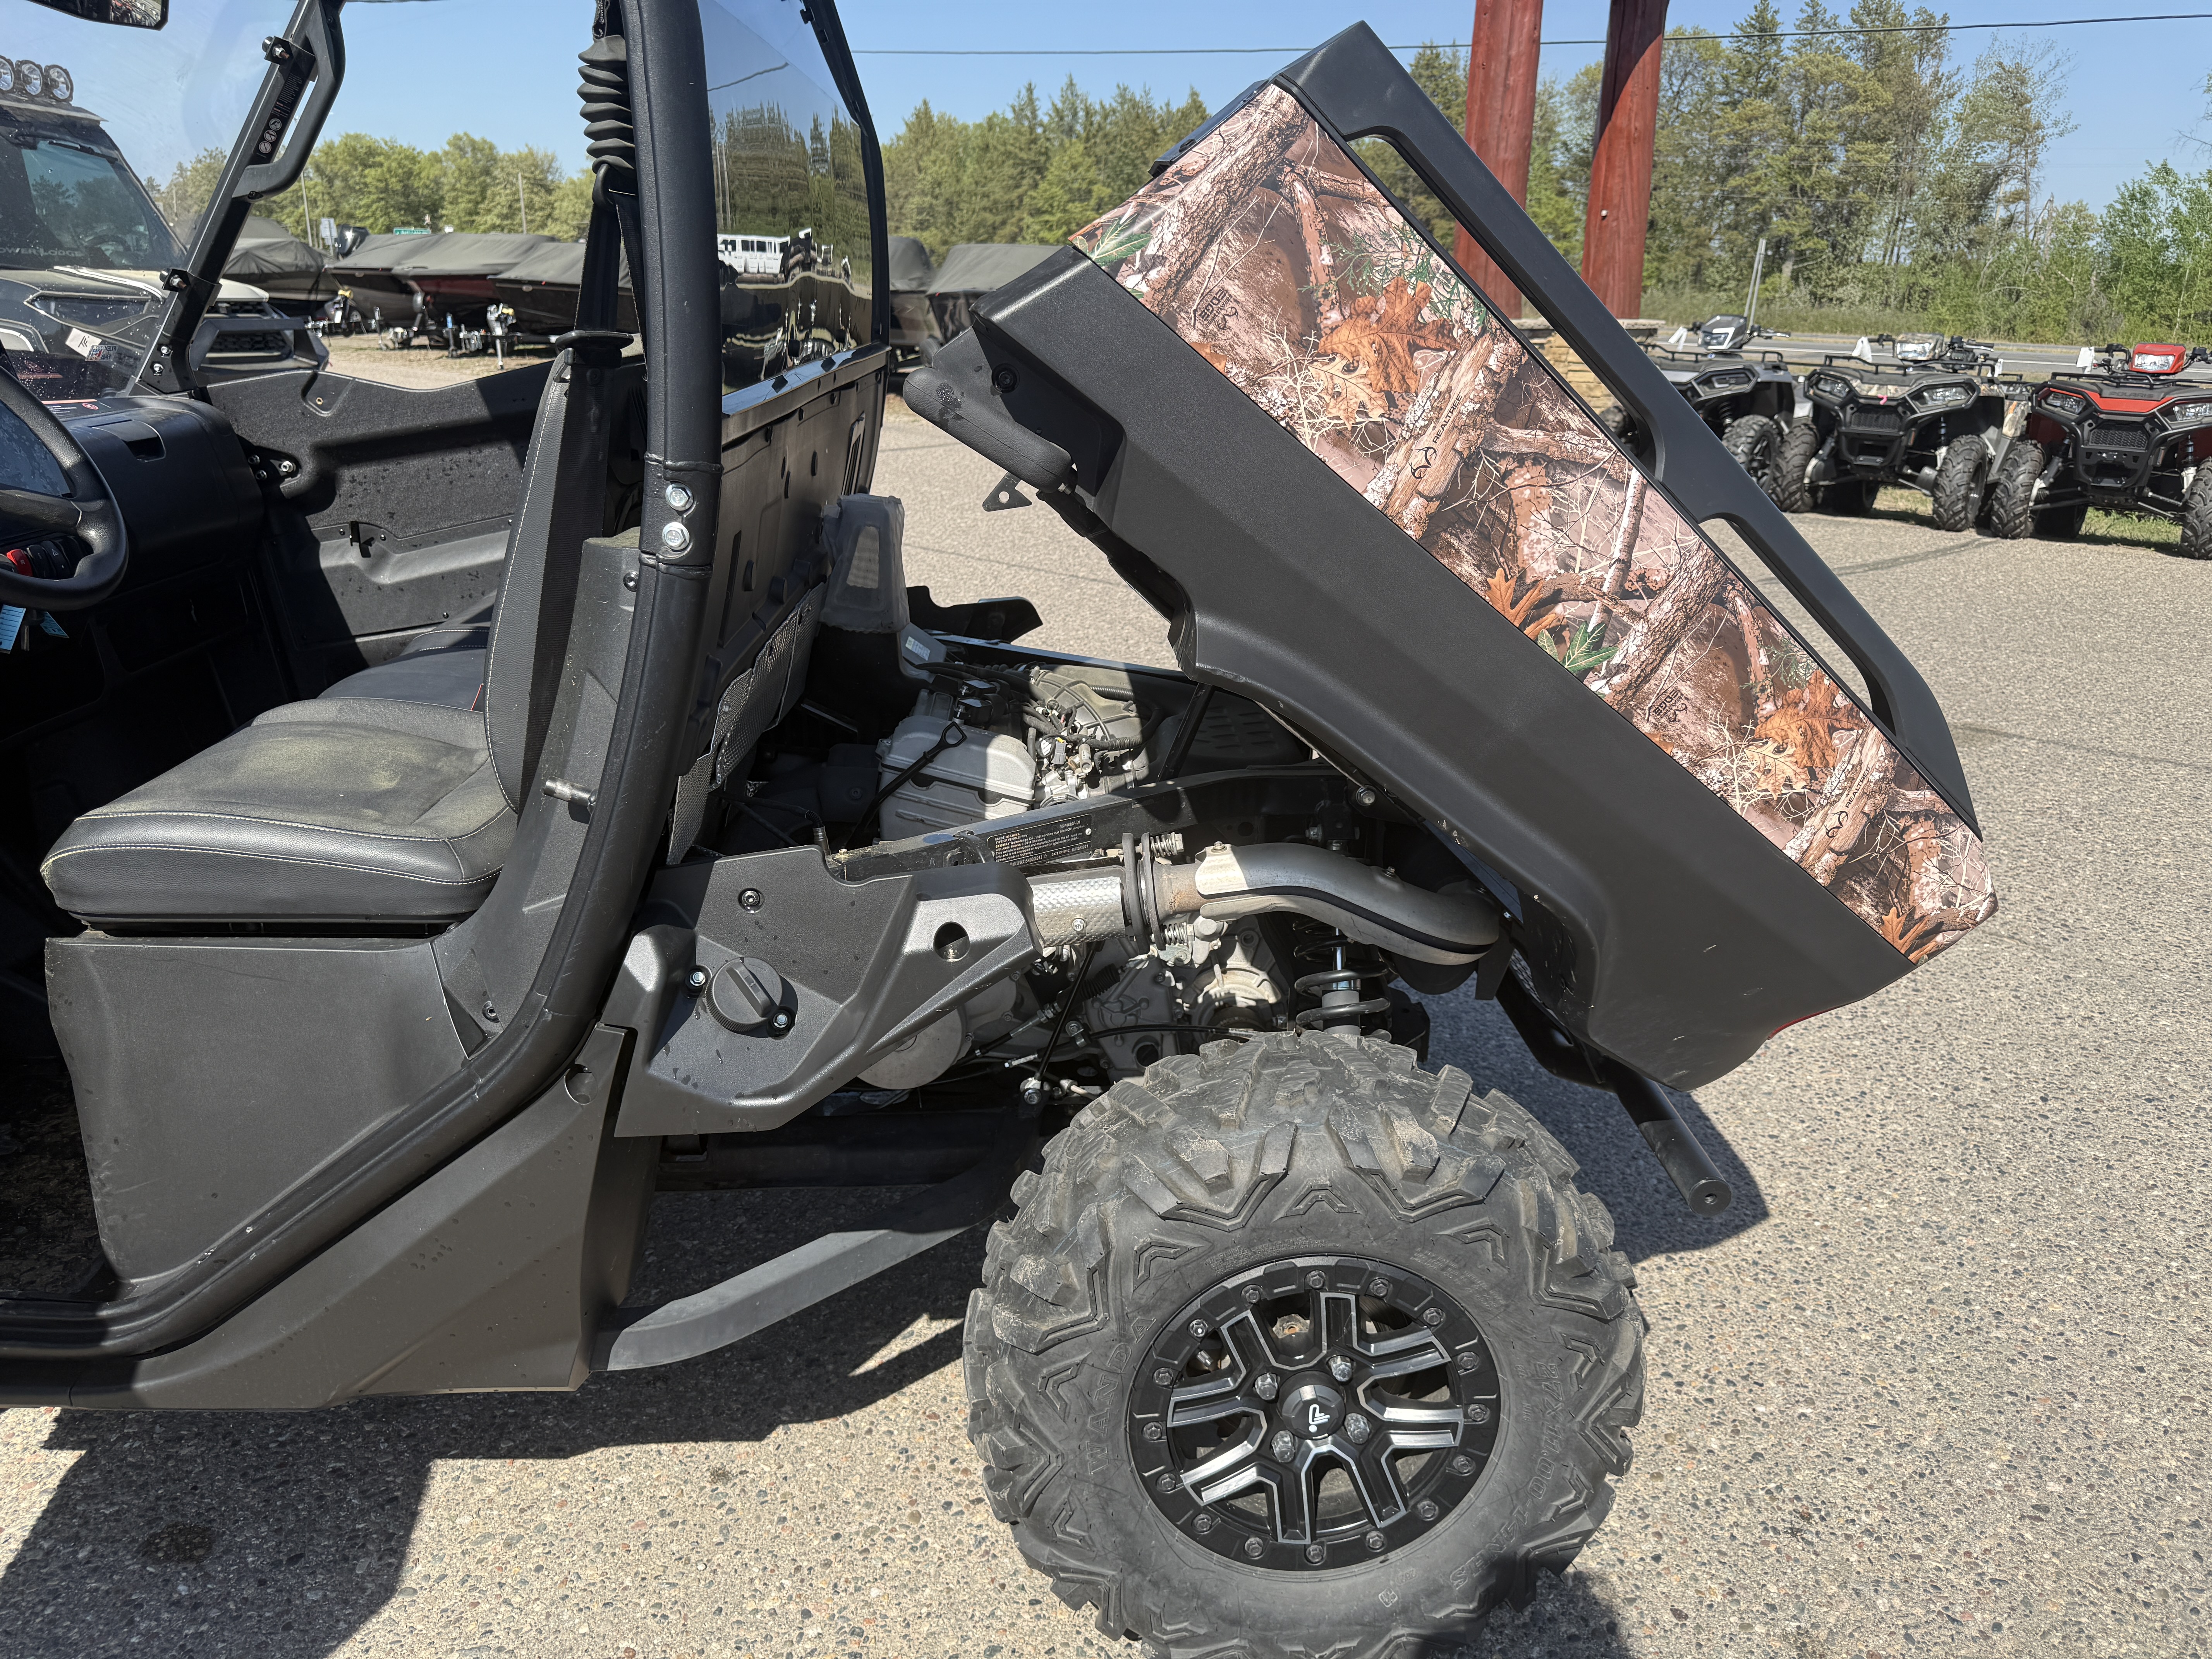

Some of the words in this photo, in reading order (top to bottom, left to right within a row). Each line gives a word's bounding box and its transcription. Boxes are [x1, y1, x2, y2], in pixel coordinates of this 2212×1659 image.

[1432, 393, 1462, 444] REALTREE
[1845, 766, 1871, 808] REALTREE
[1085, 1317, 1157, 1475] WANDA
